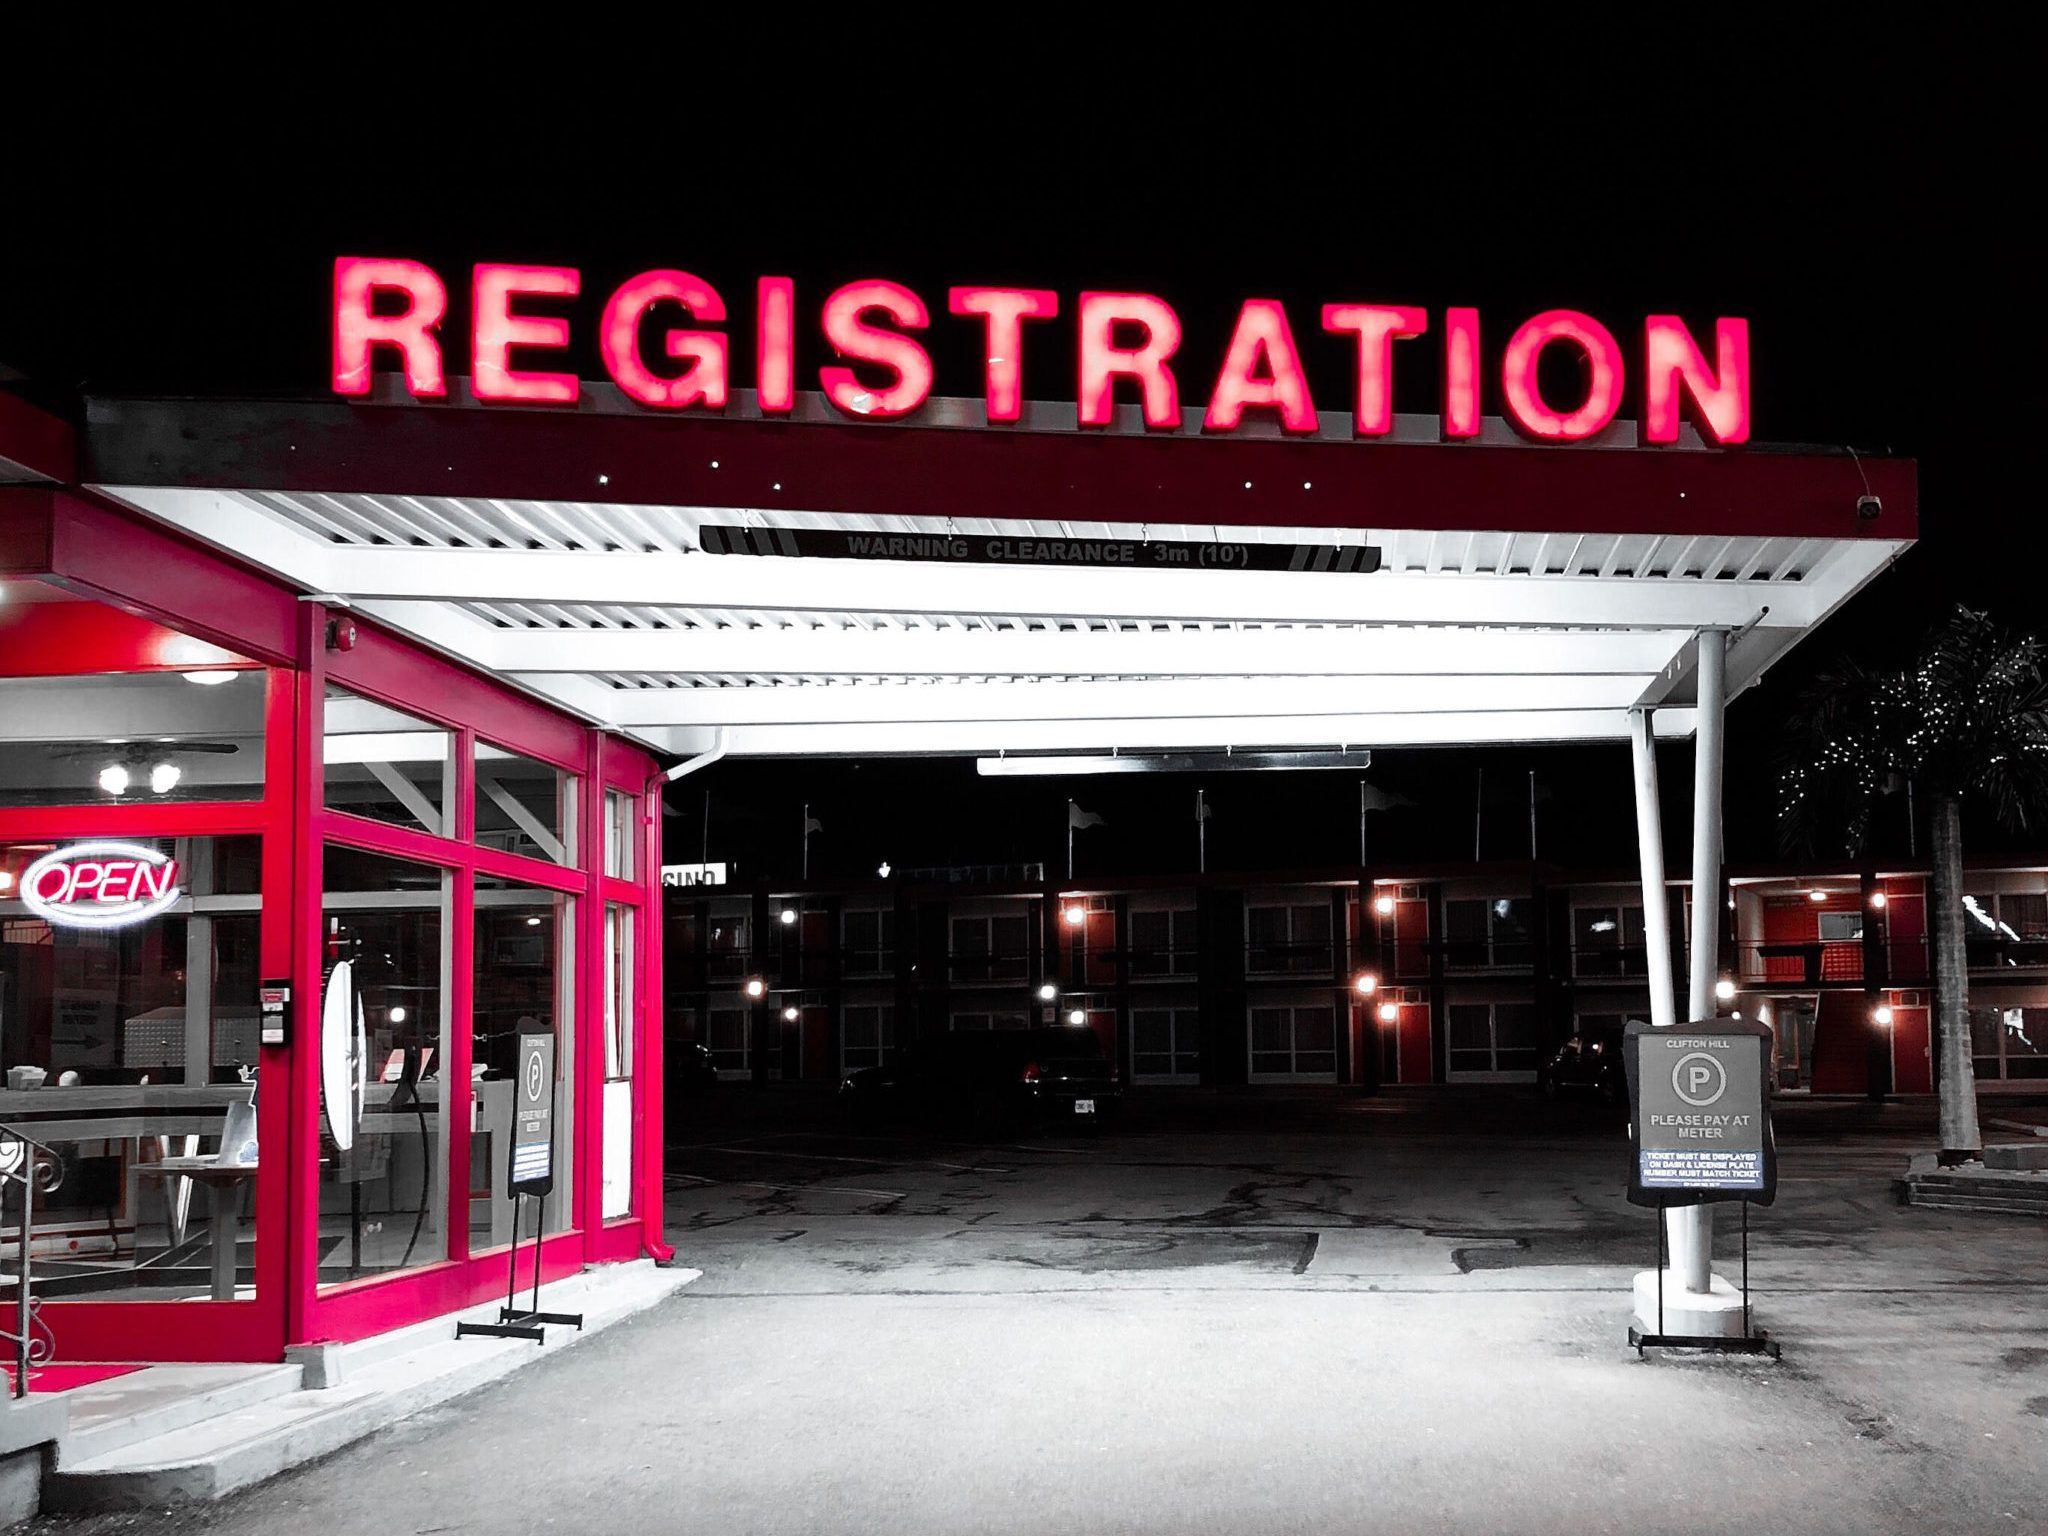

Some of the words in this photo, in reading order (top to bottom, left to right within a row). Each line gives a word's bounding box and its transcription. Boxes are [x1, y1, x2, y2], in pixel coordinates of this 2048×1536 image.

[331, 255, 1751, 446] REGISTRATION
[847, 534, 970, 559] WARNING
[986, 539, 1136, 563] CLEARANCE
[1152, 542, 1190, 563] 3m
[31, 861, 177, 903] OPEN
[1666, 1039, 1707, 1049] CLIFTON
[1708, 1039, 1730, 1049] HILL
[1689, 1066, 1711, 1093] P
[1650, 1114, 1702, 1126] PLEASE
[1703, 1114, 1730, 1126] PAY
[1732, 1115, 1750, 1126] AT
[1678, 1127, 1723, 1139] METER
[1646, 1152, 1675, 1160] TICKET
[1676, 1152, 1699, 1160] MUST
[1699, 1153, 1711, 1161] BE
[1712, 1153, 1757, 1161] DISPLAYED
[1649, 1160, 1662, 1168] ON
[1662, 1161, 1686, 1169] DASH
[1687, 1161, 1693, 1169] &
[1694, 1161, 1728, 1169] LICENSE
[1728, 1161, 1754, 1169] PLATE
[1643, 1169, 1678, 1177] NUMBER
[1678, 1169, 1701, 1177] MUST
[1702, 1170, 1731, 1178] MATCH
[1731, 1170, 1760, 1178] TICKET
